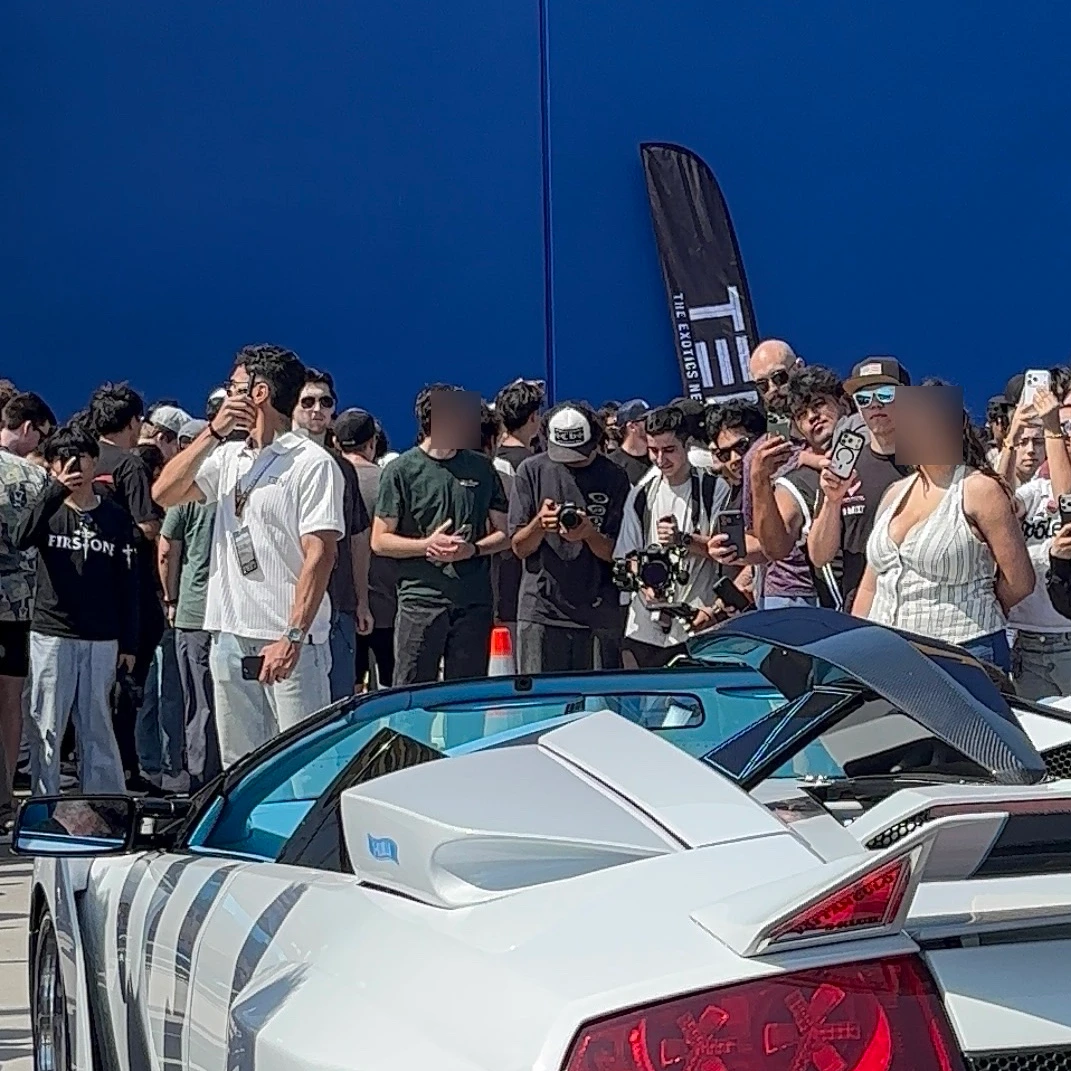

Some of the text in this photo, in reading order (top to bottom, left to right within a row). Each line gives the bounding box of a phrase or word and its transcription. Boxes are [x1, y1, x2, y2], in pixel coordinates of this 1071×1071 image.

[673, 292, 703, 401] THE EXOTICS NE
